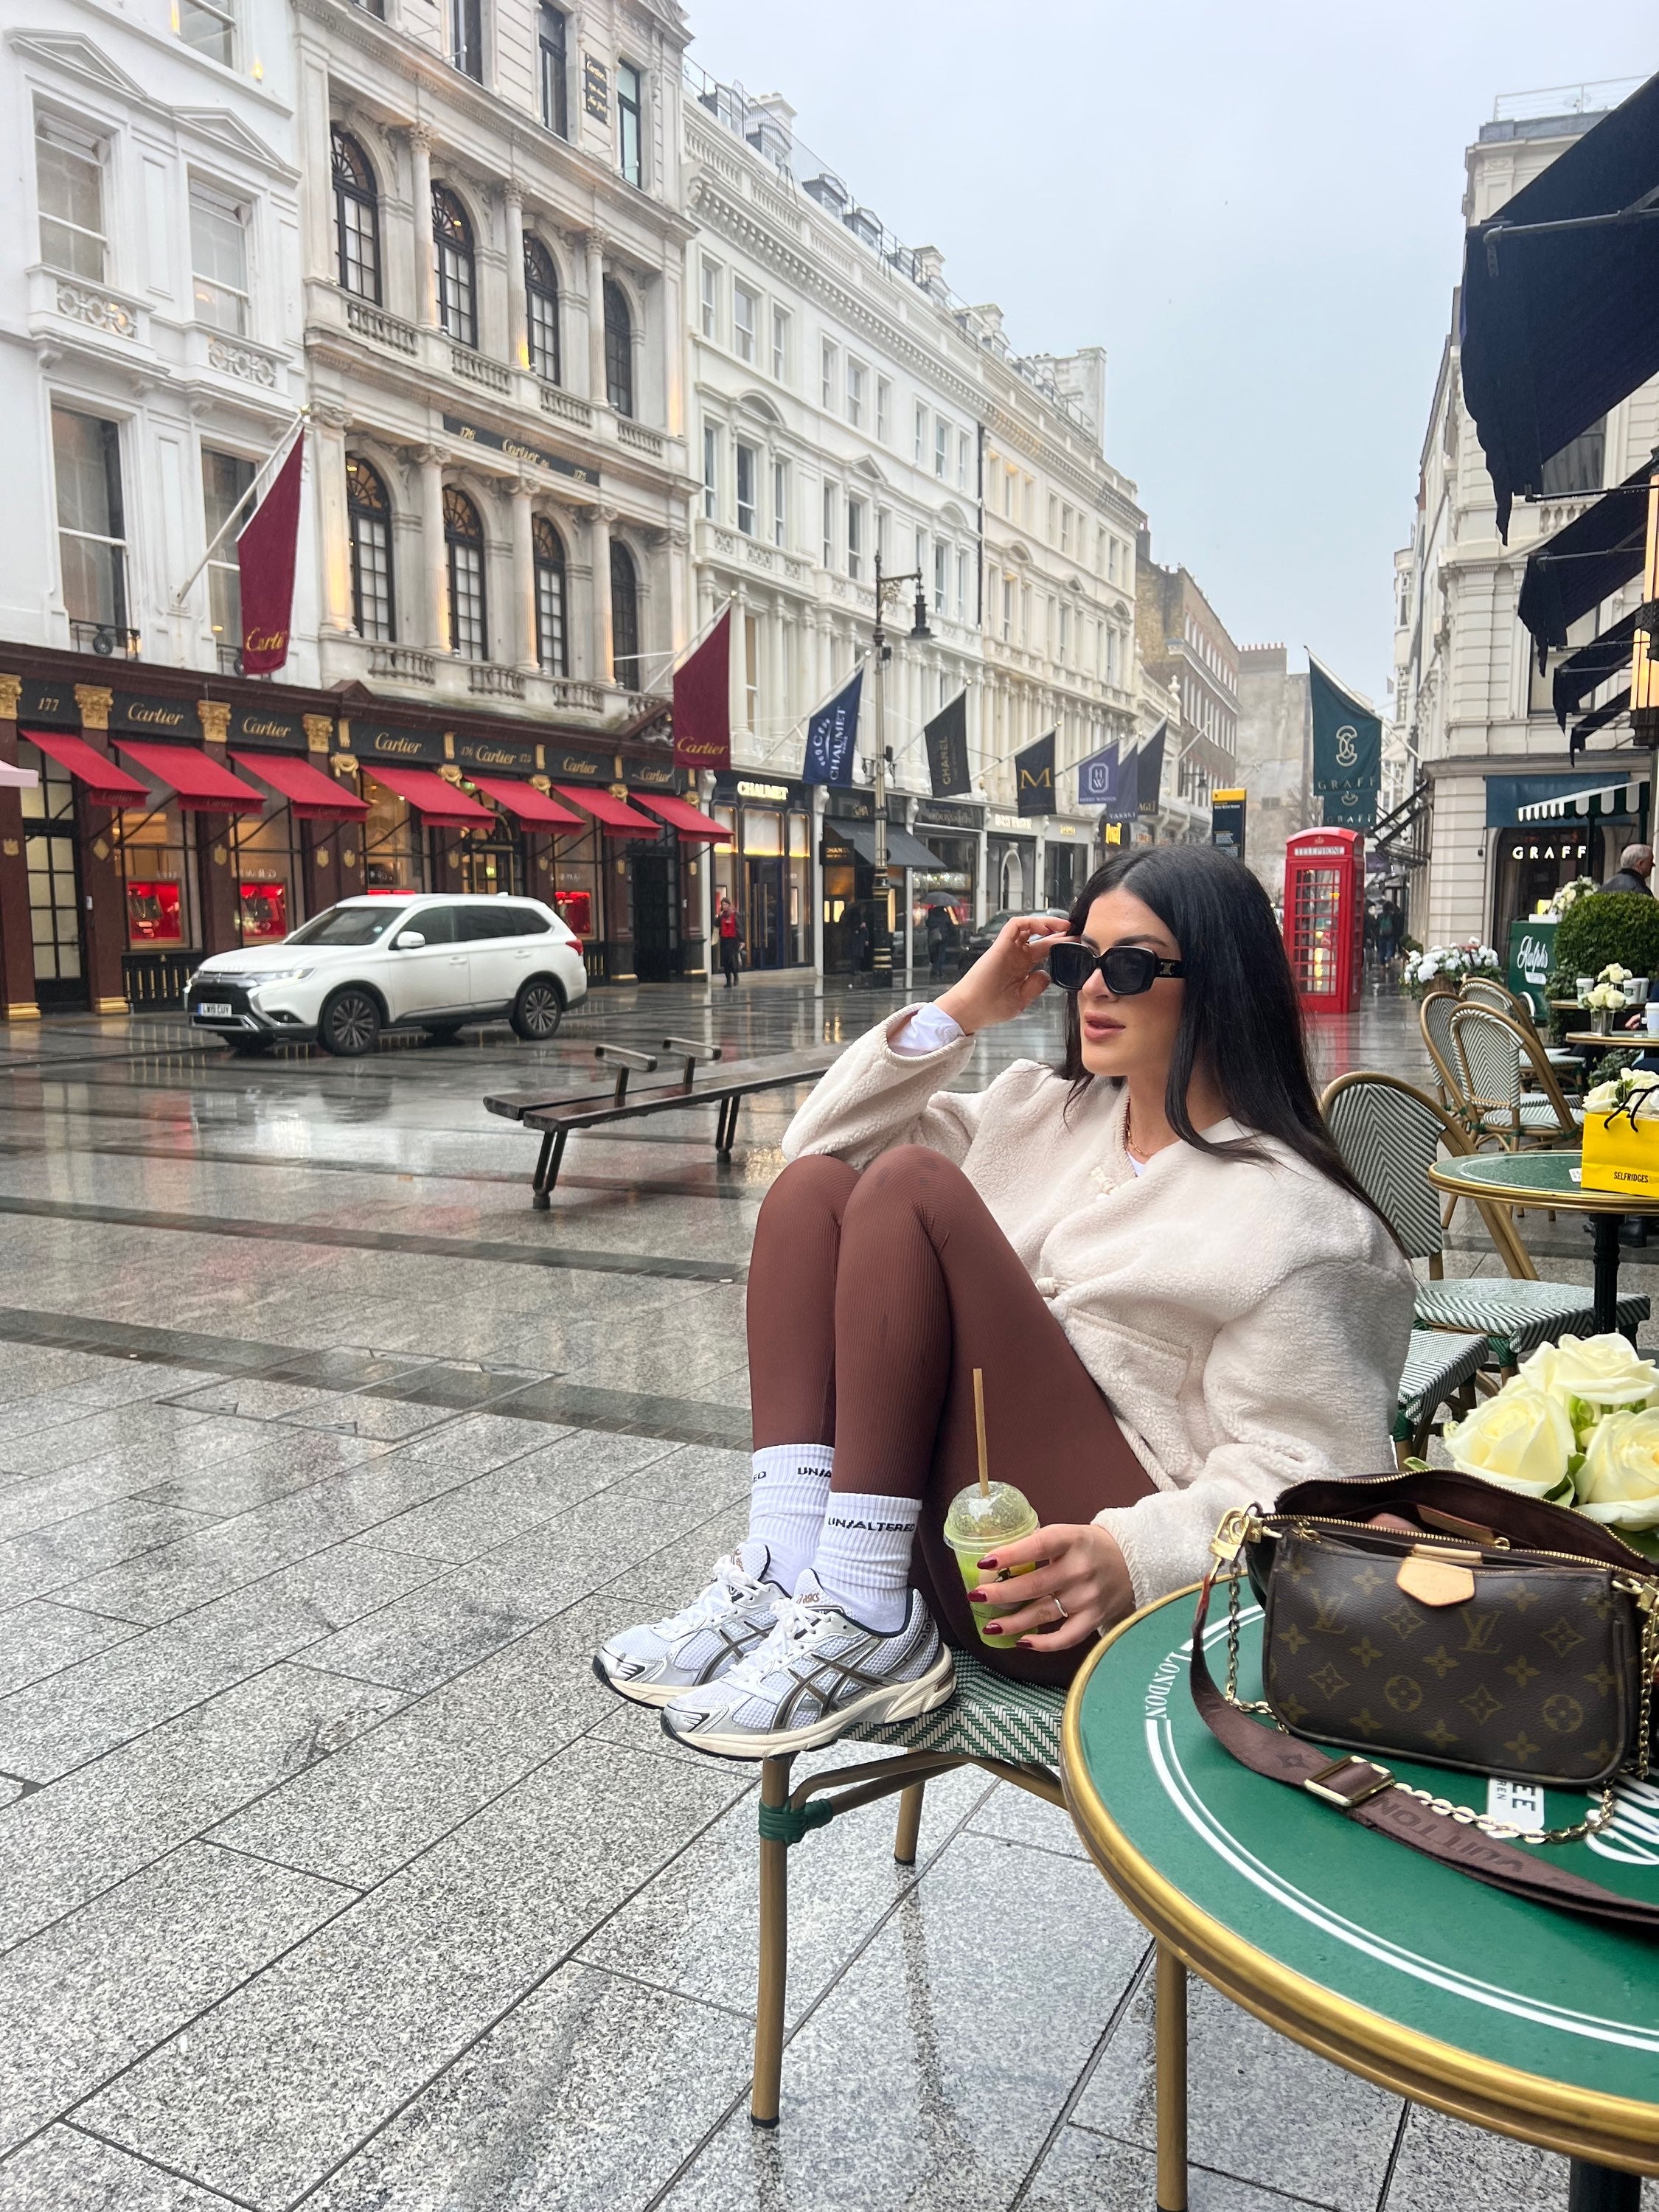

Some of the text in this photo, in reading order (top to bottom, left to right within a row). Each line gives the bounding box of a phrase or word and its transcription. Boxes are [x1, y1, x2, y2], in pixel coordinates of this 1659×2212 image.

[460, 426, 476, 441] 176
[502, 438, 540, 465] Cartier
[38, 697, 59, 712] 177
[128, 702, 184, 726] Cartier
[243, 716, 291, 737] Cartier
[375, 731, 422, 754] Cartier
[677, 737, 727, 755] Cartier
[830, 706, 846, 781] CHAUMET
[475, 745, 517, 765] Cartier
[939, 736, 952, 785] CHANEL
[563, 756, 599, 775] Cartier
[639, 766, 672, 784] Cartier
[1019, 767, 1053, 790] M
[1318, 776, 1376, 790] GRAFF
[737, 781, 789, 800] CHAUMET
[1138, 800, 1157, 813] AGET
[1327, 813, 1373, 824] GRAFF
[1297, 846, 1342, 855] TELEPHONE
[1512, 845, 1587, 860] GRAFF
[1613, 1171, 1649, 1183] SELFRIDGES
[1144, 1651, 1192, 1719] LONDON
